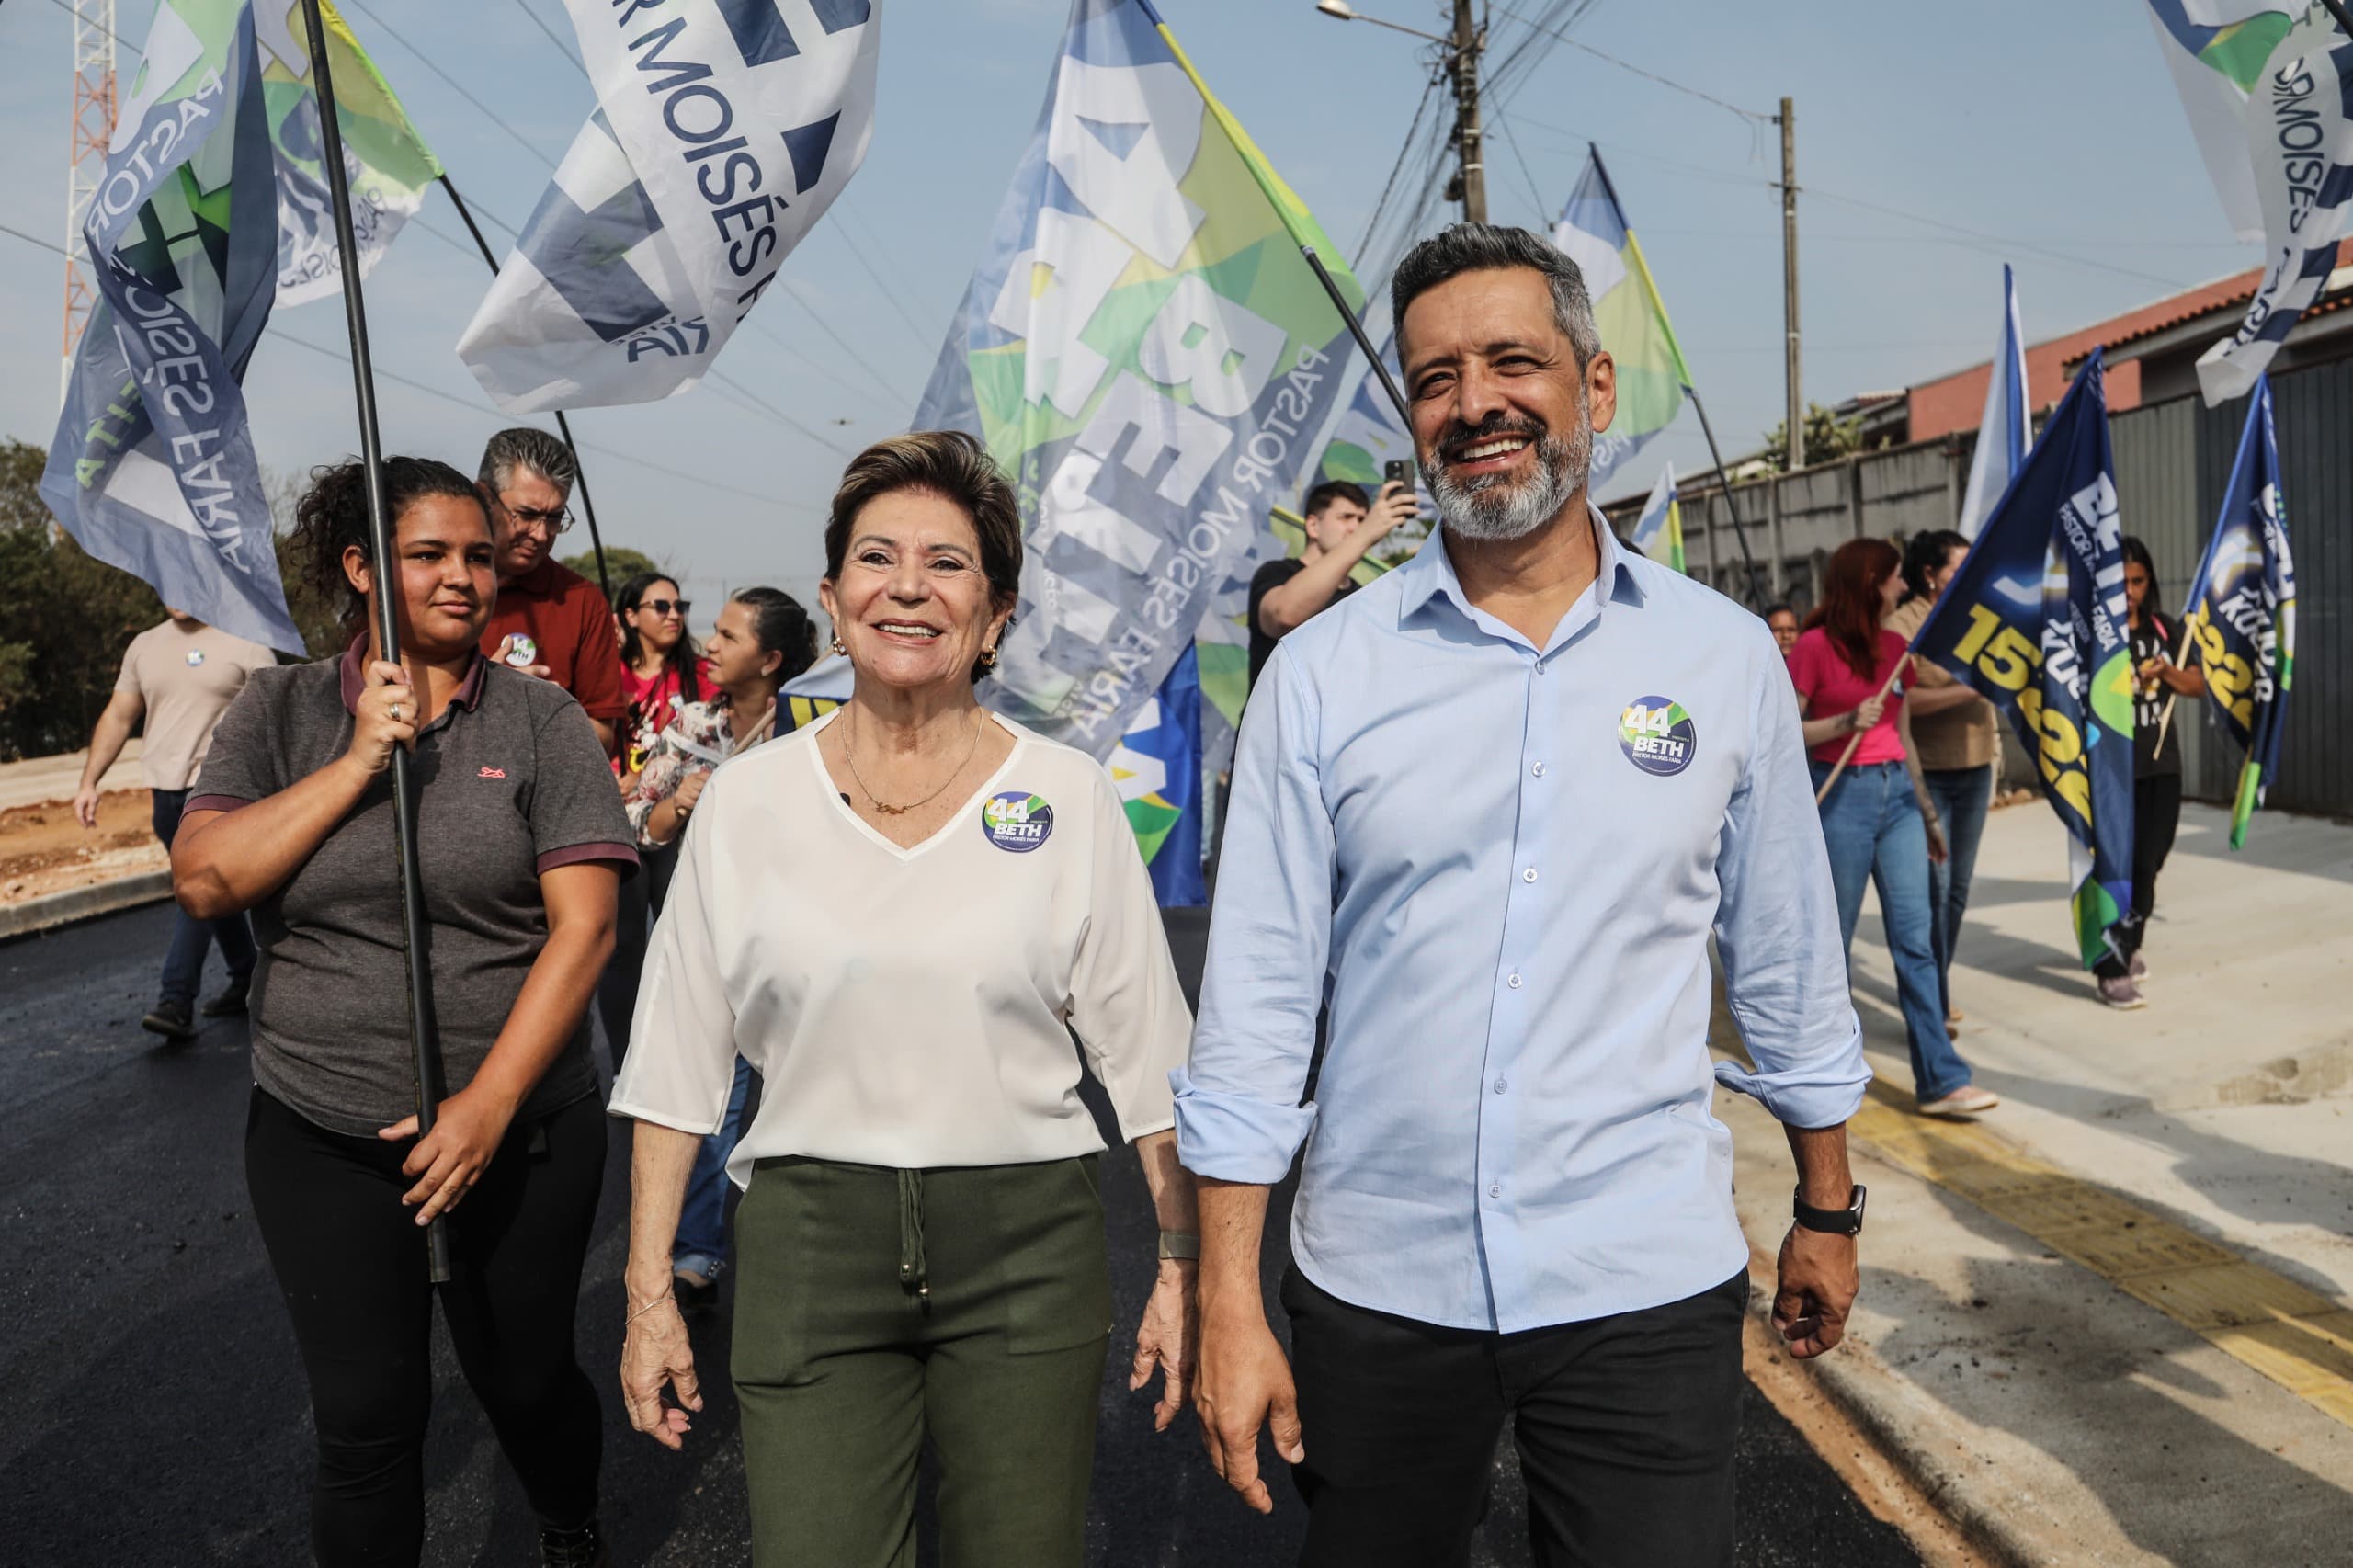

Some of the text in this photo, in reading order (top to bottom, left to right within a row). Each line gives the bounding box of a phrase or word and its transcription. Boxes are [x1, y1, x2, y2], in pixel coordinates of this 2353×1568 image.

[628, 16, 789, 278] MOISÉS
[1624, 704, 1672, 737] 44
[1633, 735, 1685, 758] BETH
[987, 798, 1029, 823] 44
[994, 822, 1042, 837] BETH
